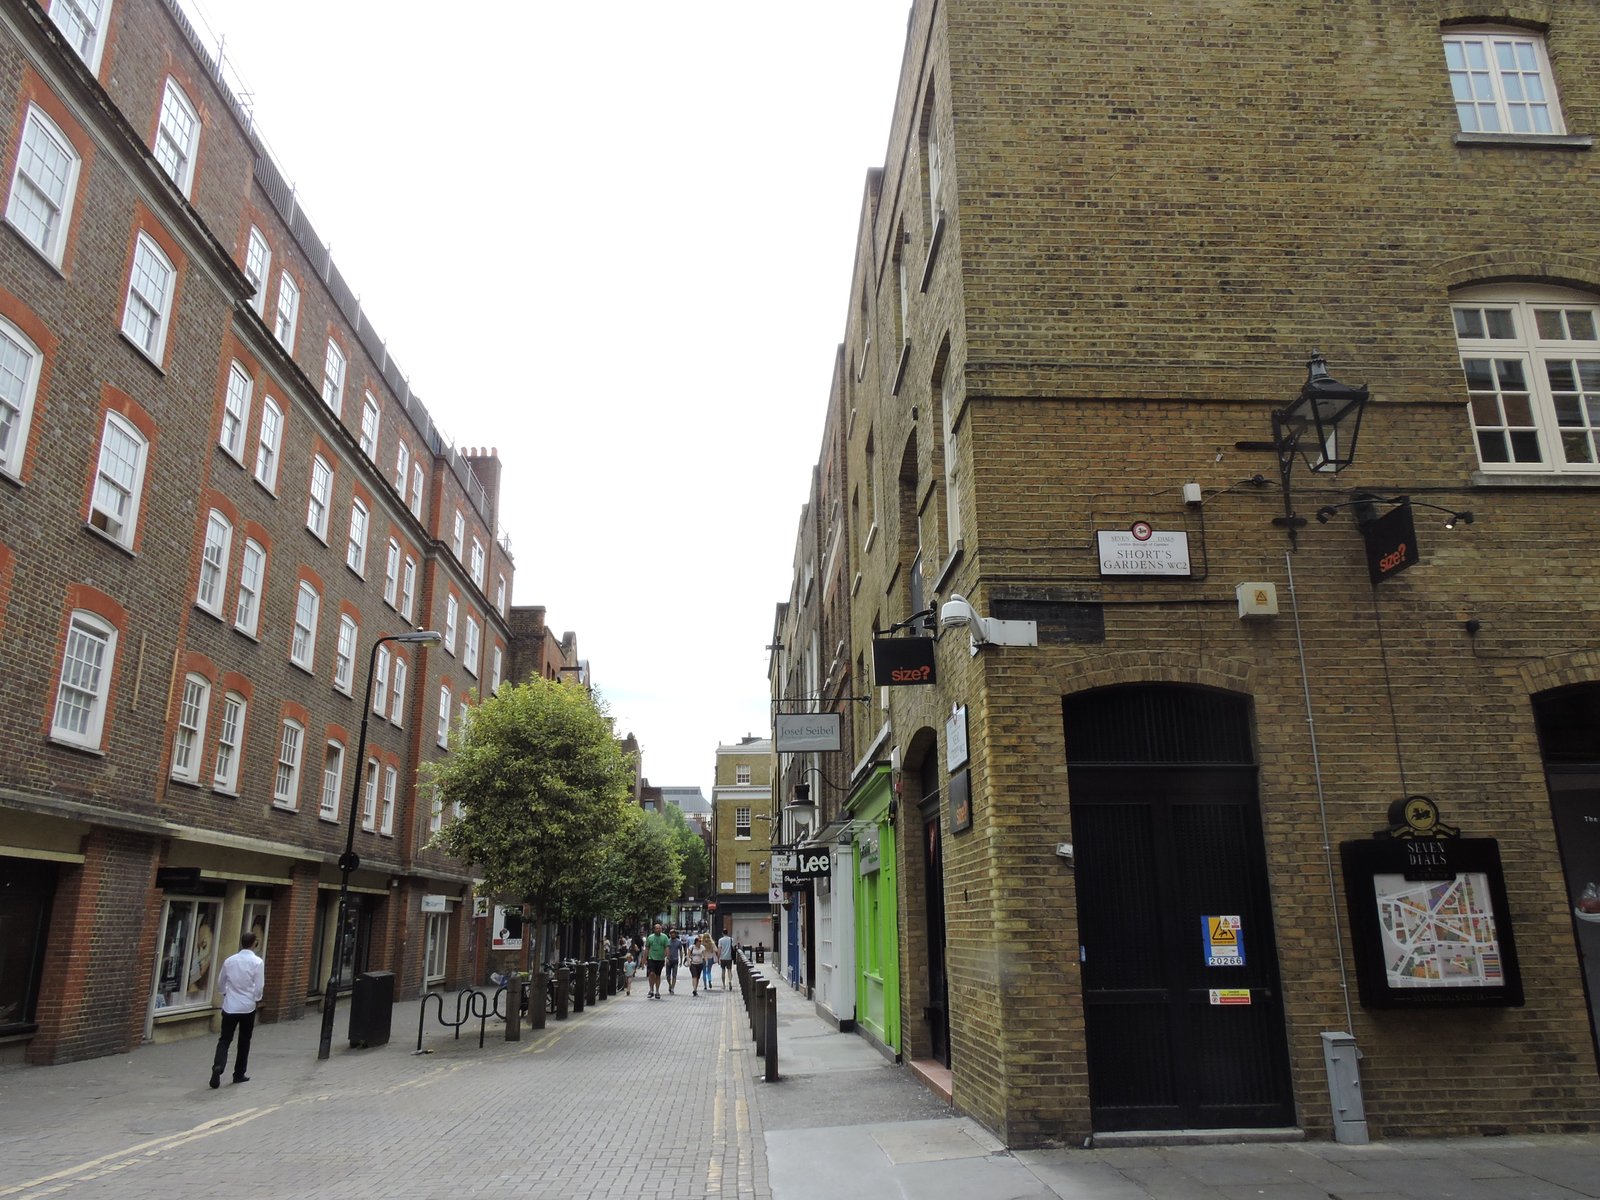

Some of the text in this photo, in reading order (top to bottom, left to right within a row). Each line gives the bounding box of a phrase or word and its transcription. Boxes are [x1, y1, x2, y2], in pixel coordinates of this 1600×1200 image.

[1117, 550, 1172, 559] SHORT'S
[1380, 543, 1406, 572] size?
[1103, 560, 1187, 570] GARDENS WC2
[891, 665, 931, 682] size?
[780, 725, 834, 737] Josef Seibel
[1584, 815, 1598, 823] The
[1407, 841, 1445, 853] SEVEN
[798, 854, 829, 872] Lee
[1409, 853, 1447, 865] DIALS
[1210, 957, 1241, 965] 20266
